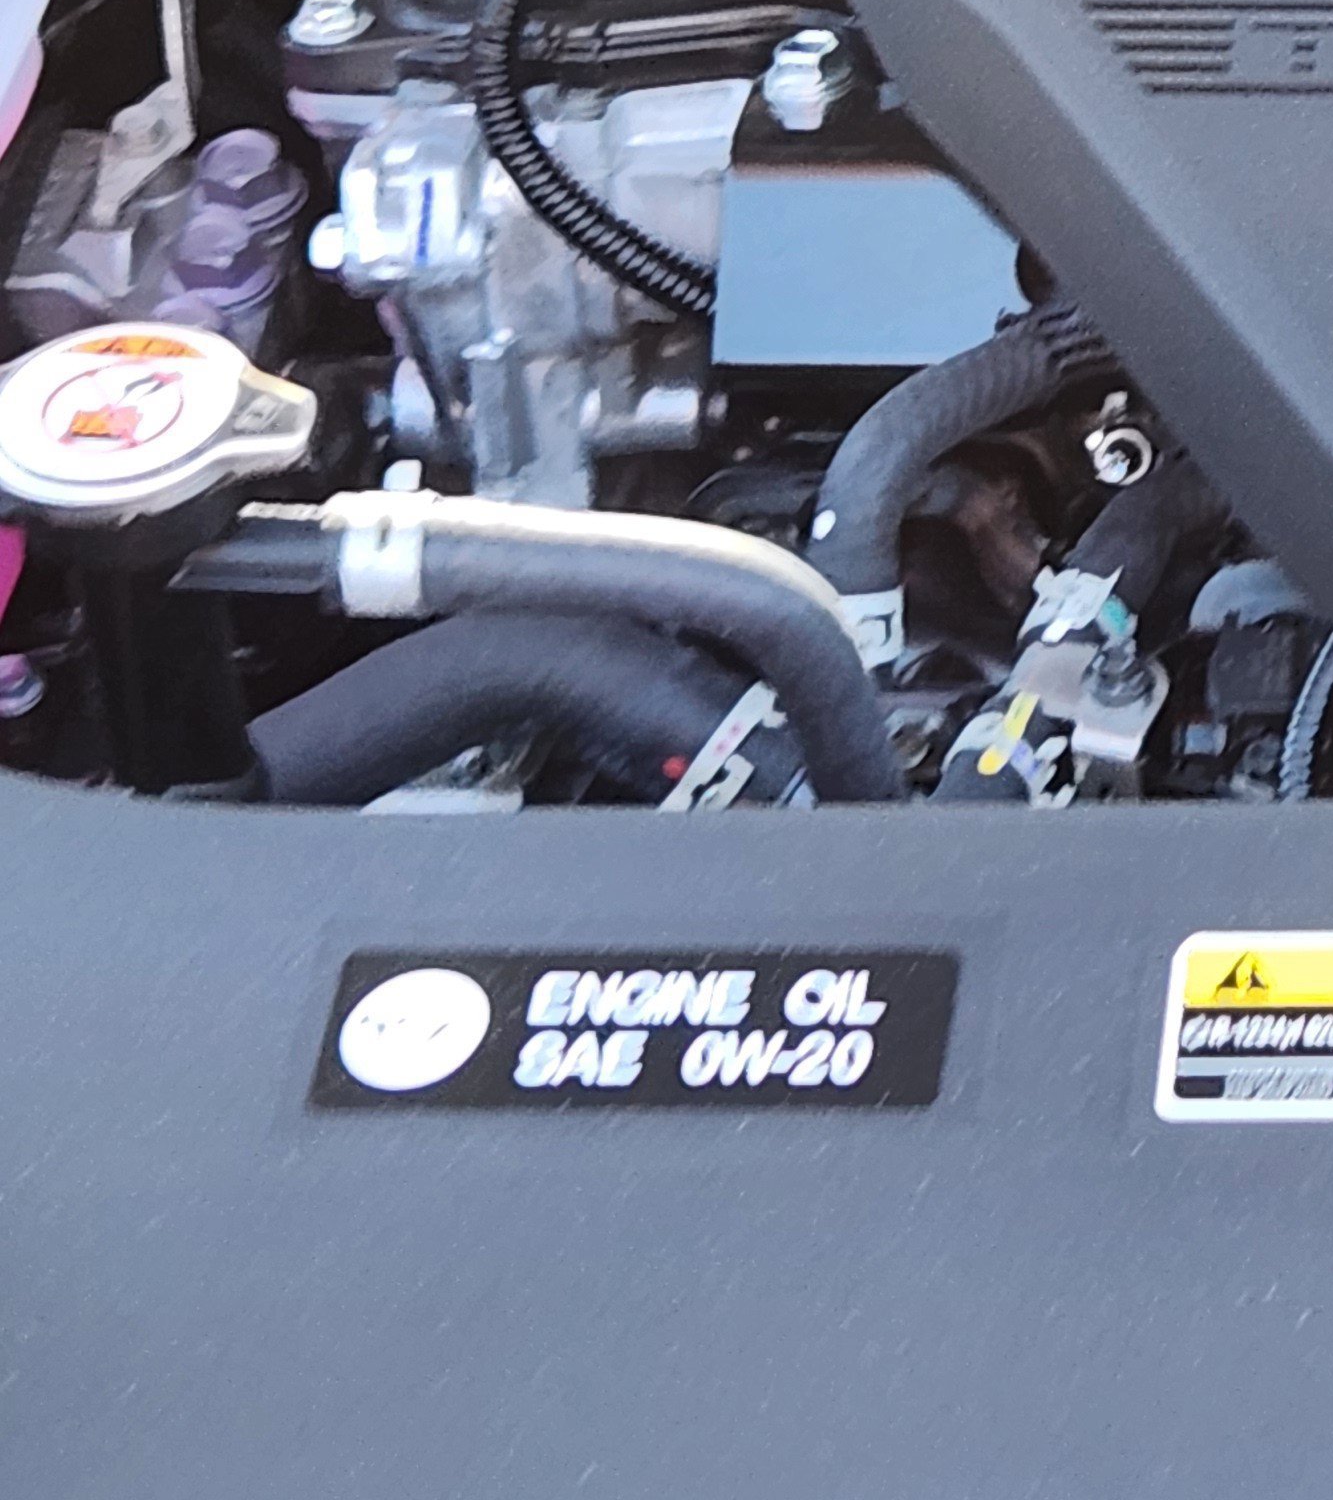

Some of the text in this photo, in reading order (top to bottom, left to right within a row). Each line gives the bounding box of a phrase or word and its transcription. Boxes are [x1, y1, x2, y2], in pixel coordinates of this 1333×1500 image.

[526, 969, 887, 1026] ENGINE OIL
[512, 1029, 874, 1087] SAE 0W-20
